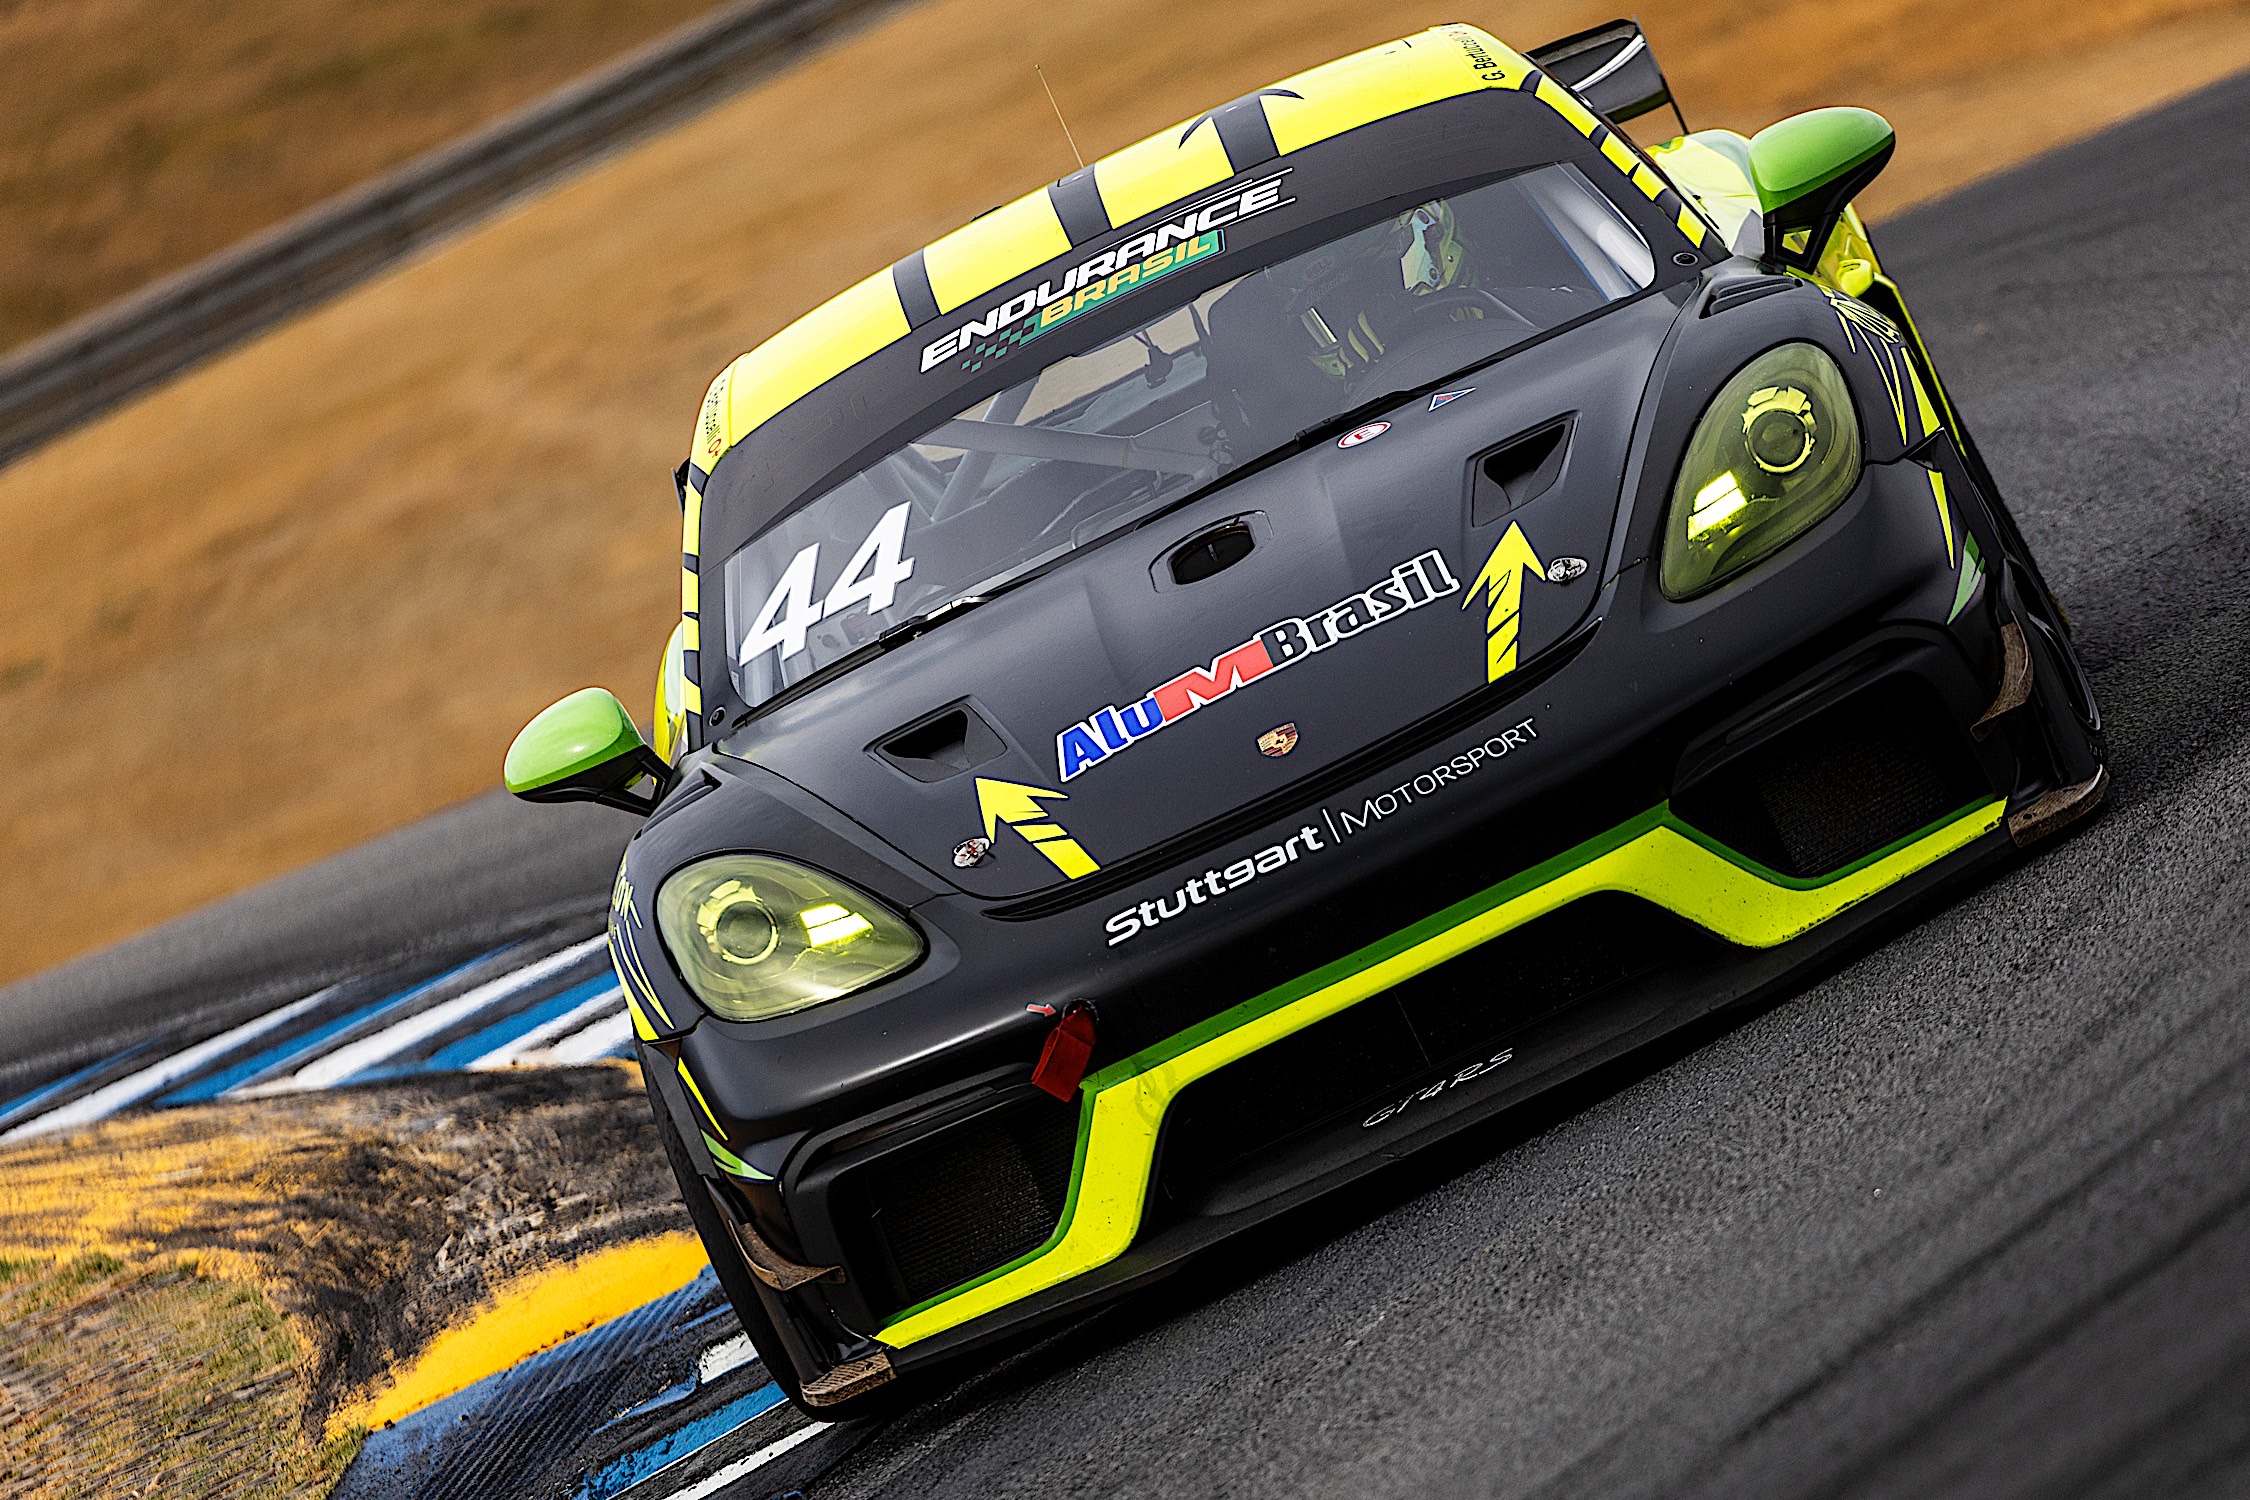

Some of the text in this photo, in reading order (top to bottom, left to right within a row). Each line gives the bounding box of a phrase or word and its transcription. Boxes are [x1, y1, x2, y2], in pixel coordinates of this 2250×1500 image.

[920, 178, 1283, 374] ENDURANCE
[1040, 238, 1212, 328] BRASIL
[739, 500, 915, 667] 44
[1105, 717, 1540, 947] Stuttgart MOTORSPORT
